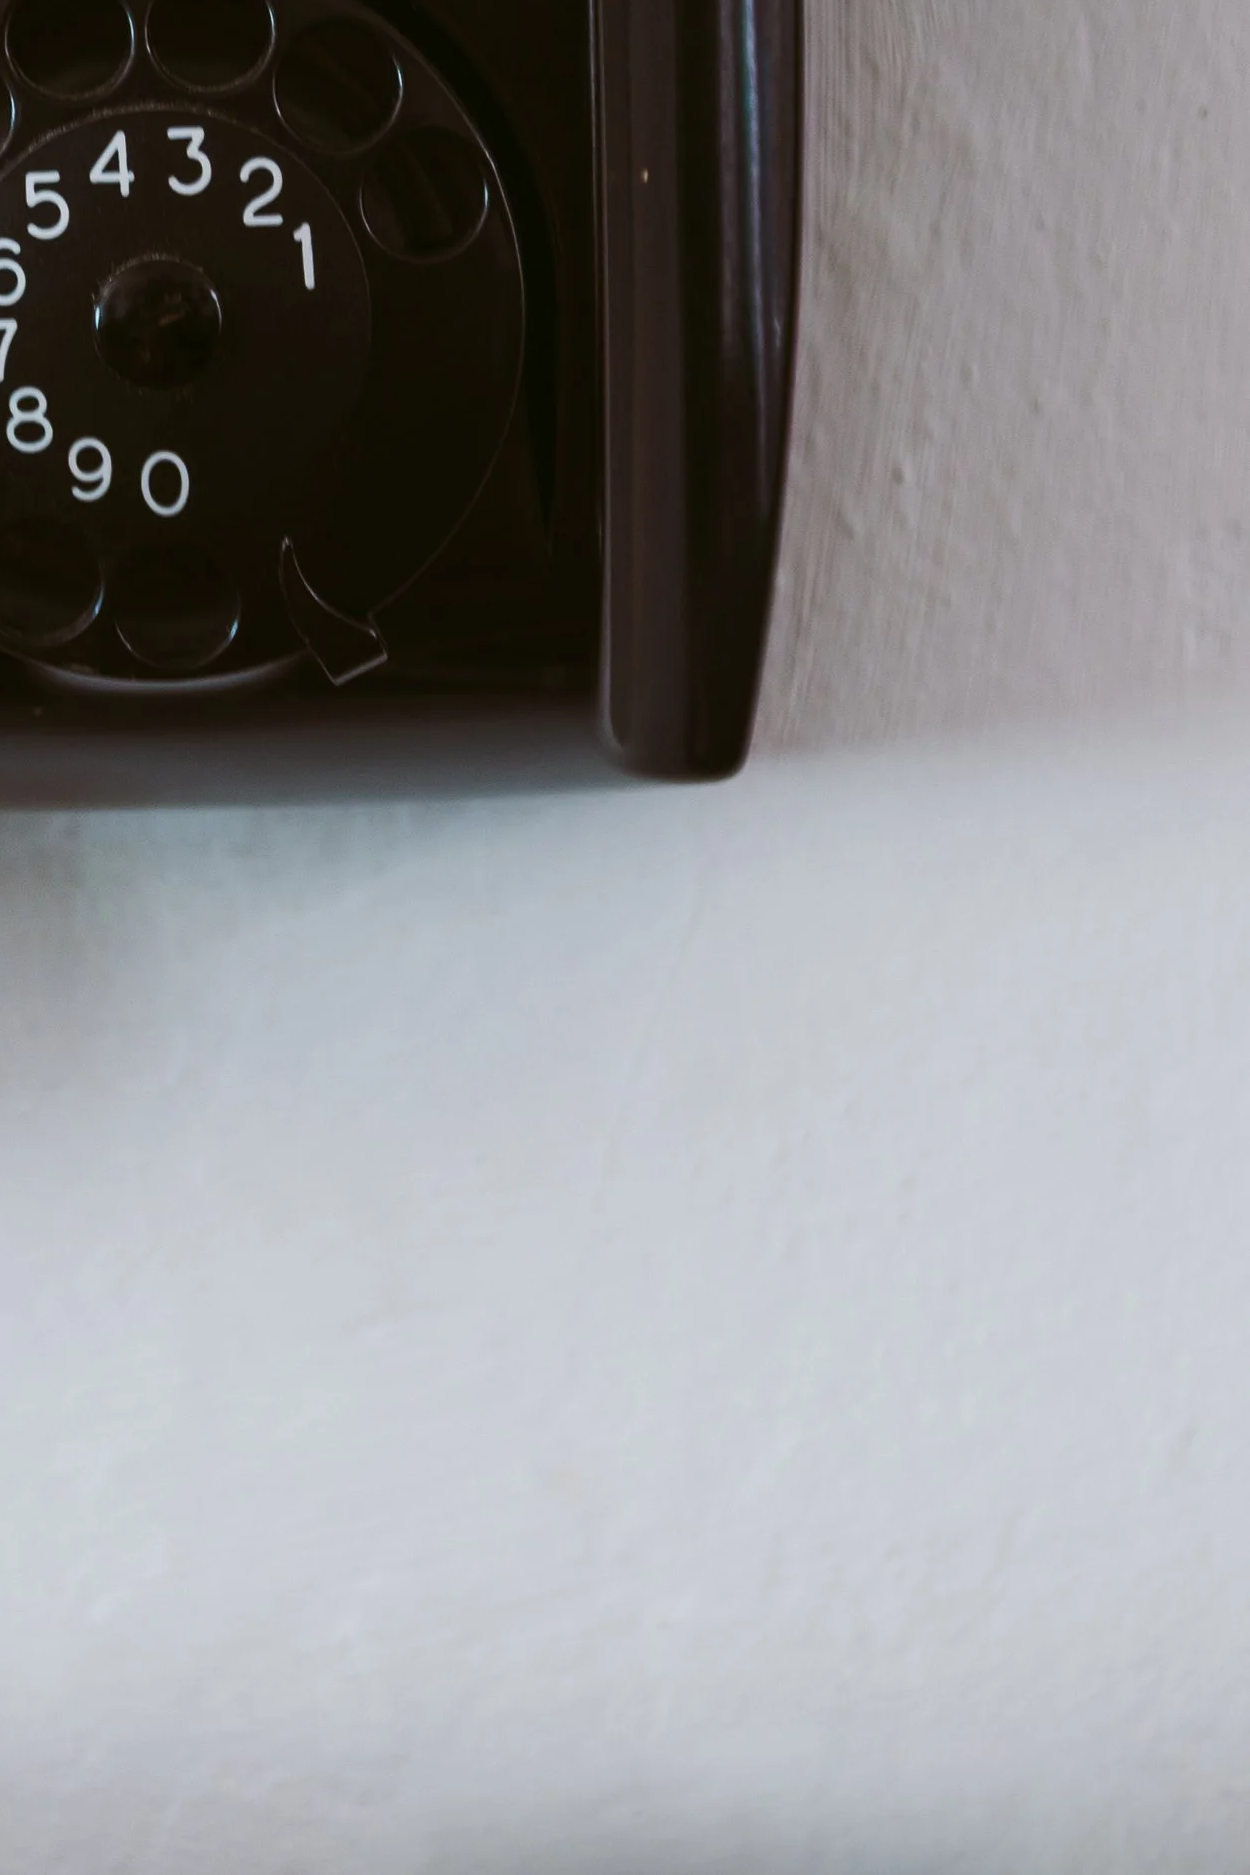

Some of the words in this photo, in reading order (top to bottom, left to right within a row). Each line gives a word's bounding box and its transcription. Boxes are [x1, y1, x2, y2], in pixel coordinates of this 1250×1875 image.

[89, 130, 135, 198] 4
[166, 126, 212, 196] 3
[239, 156, 284, 227] 2
[25, 170, 70, 240] 5
[293, 222, 315, 291] 1
[5, 386, 54, 454] 8
[67, 437, 113, 502] 9
[140, 450, 190, 517] 0
